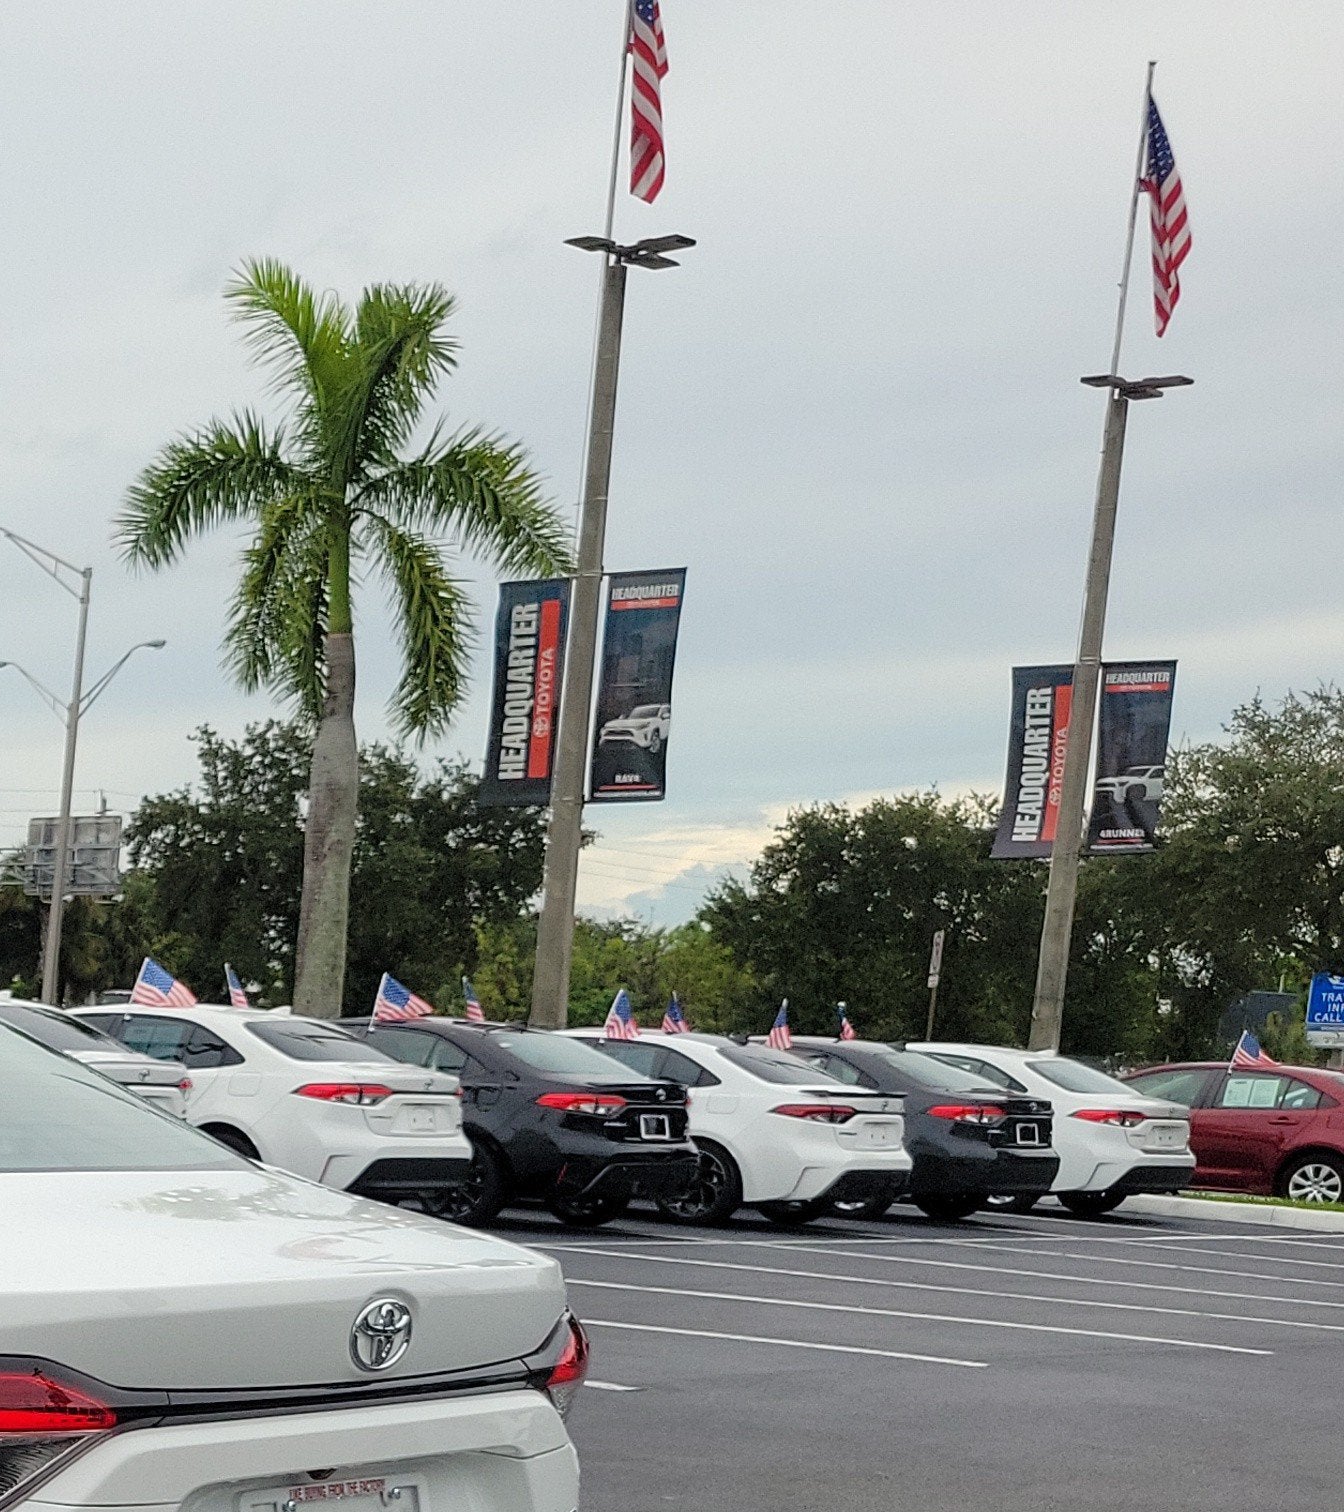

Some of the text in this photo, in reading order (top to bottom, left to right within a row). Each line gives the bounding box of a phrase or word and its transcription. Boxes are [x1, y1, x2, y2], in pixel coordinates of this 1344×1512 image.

[611, 584, 679, 600] HEADQUARTER
[498, 602, 539, 780] HEADQUARTER
[537, 647, 556, 715] TOYOTA
[1106, 671, 1170, 685] HEADQUARTER
[1012, 686, 1054, 842] HEADQUARTER
[1052, 726, 1070, 784] TOYOTA
[1322, 992, 1344, 1003] TRA
[1314, 1012, 1342, 1023] CALL
